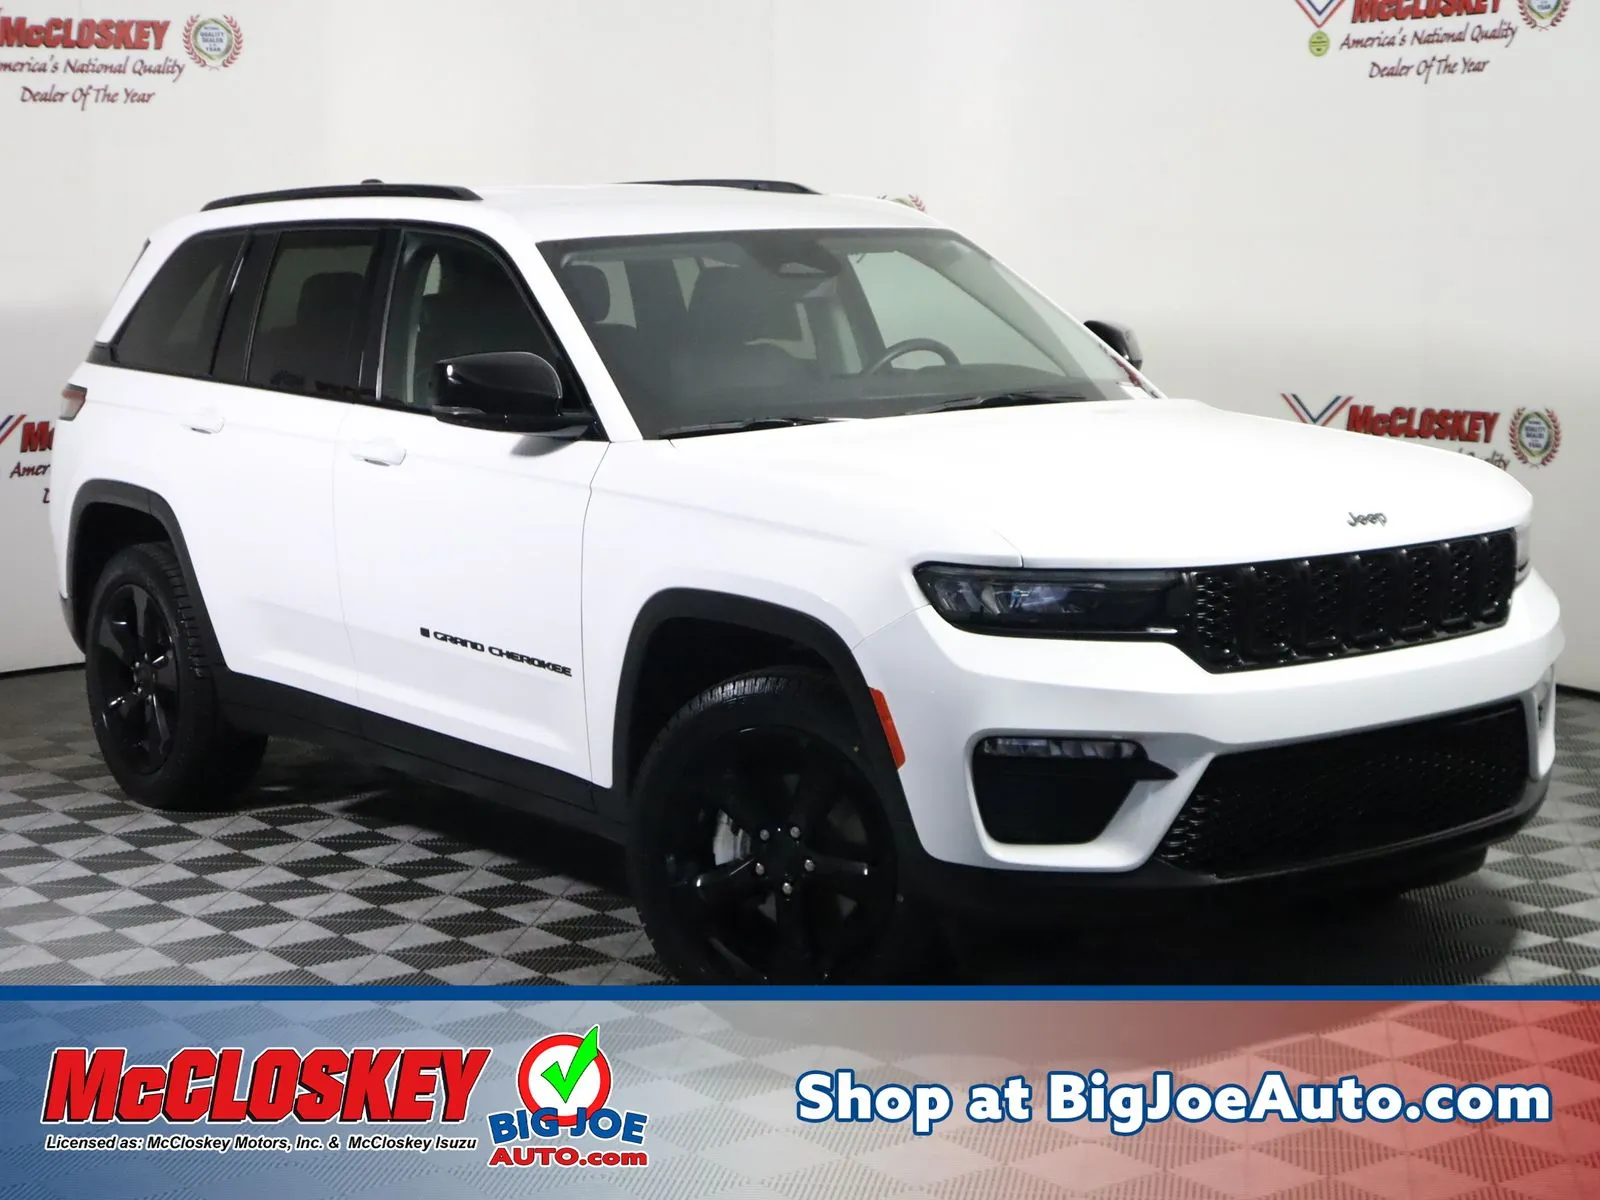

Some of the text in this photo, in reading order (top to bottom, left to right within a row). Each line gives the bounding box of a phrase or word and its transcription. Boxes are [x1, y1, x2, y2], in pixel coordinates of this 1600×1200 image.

[0, 17, 171, 50] McCLOSKEY
[1339, 27, 1407, 50] America's
[1411, 23, 1469, 46] National
[1470, 20, 1519, 48] Quality
[0, 55, 186, 83] merica's National Quality
[1369, 54, 1490, 84] Dealer Of The Year
[20, 84, 156, 111] Dealer Of The Year
[1346, 405, 1500, 443] McCLOSKEY
[1346, 512, 1388, 527] Jeep
[433, 631, 573, 677] GRAND CHEROKEE
